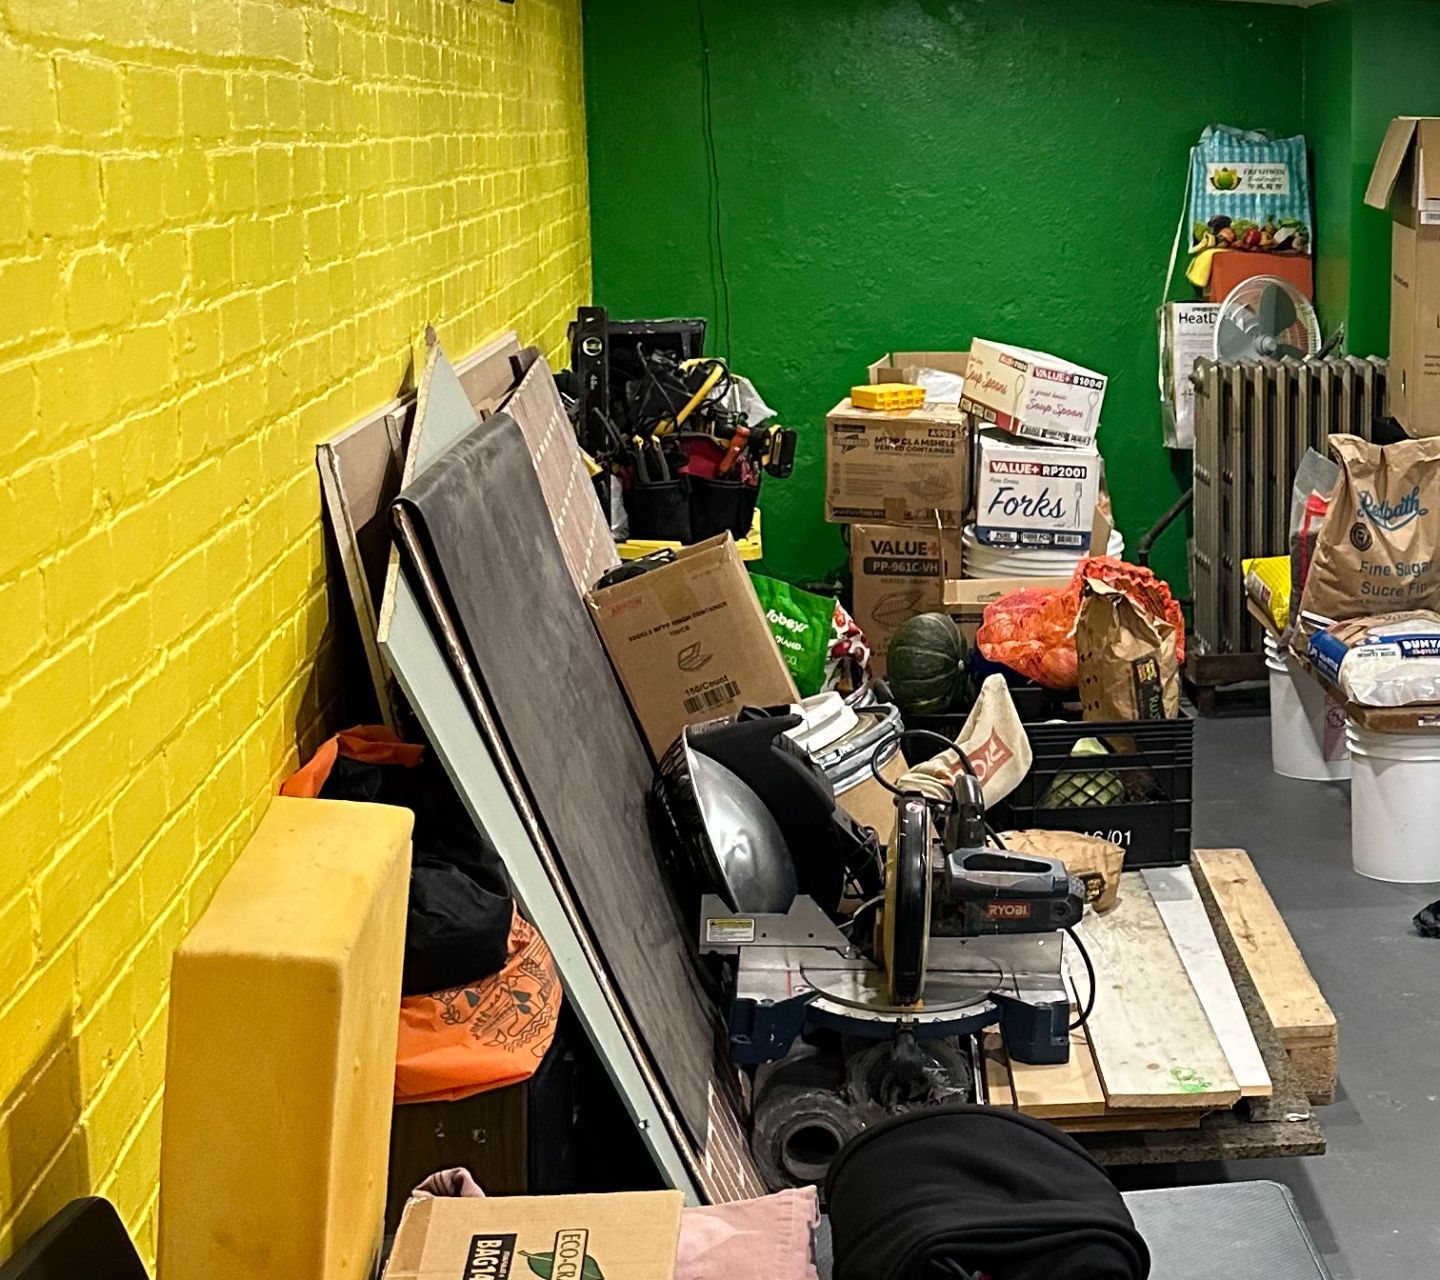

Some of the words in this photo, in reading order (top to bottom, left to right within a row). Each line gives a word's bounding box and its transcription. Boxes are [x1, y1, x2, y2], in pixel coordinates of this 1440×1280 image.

[1179, 312, 1218, 325] HeatD
[1035, 368, 1071, 383] VALUE+
[1026, 398, 1052, 415] Soup
[901, 438, 956, 448] CLAMSHELL
[905, 446, 956, 455] CONTAINERS
[991, 462, 1040, 475] VALUE+
[1042, 465, 1086, 478] RP2001
[988, 486, 1066, 519] Forks
[1357, 486, 1428, 525] Redpath
[870, 540, 939, 556] VALUE+
[873, 560, 938, 572] PP-961C-VH
[1359, 561, 1392, 577] Fine
[1395, 561, 1433, 578] Sugar
[1360, 581, 1404, 597] Sucre
[988, 903, 1029, 916] RYOBI
